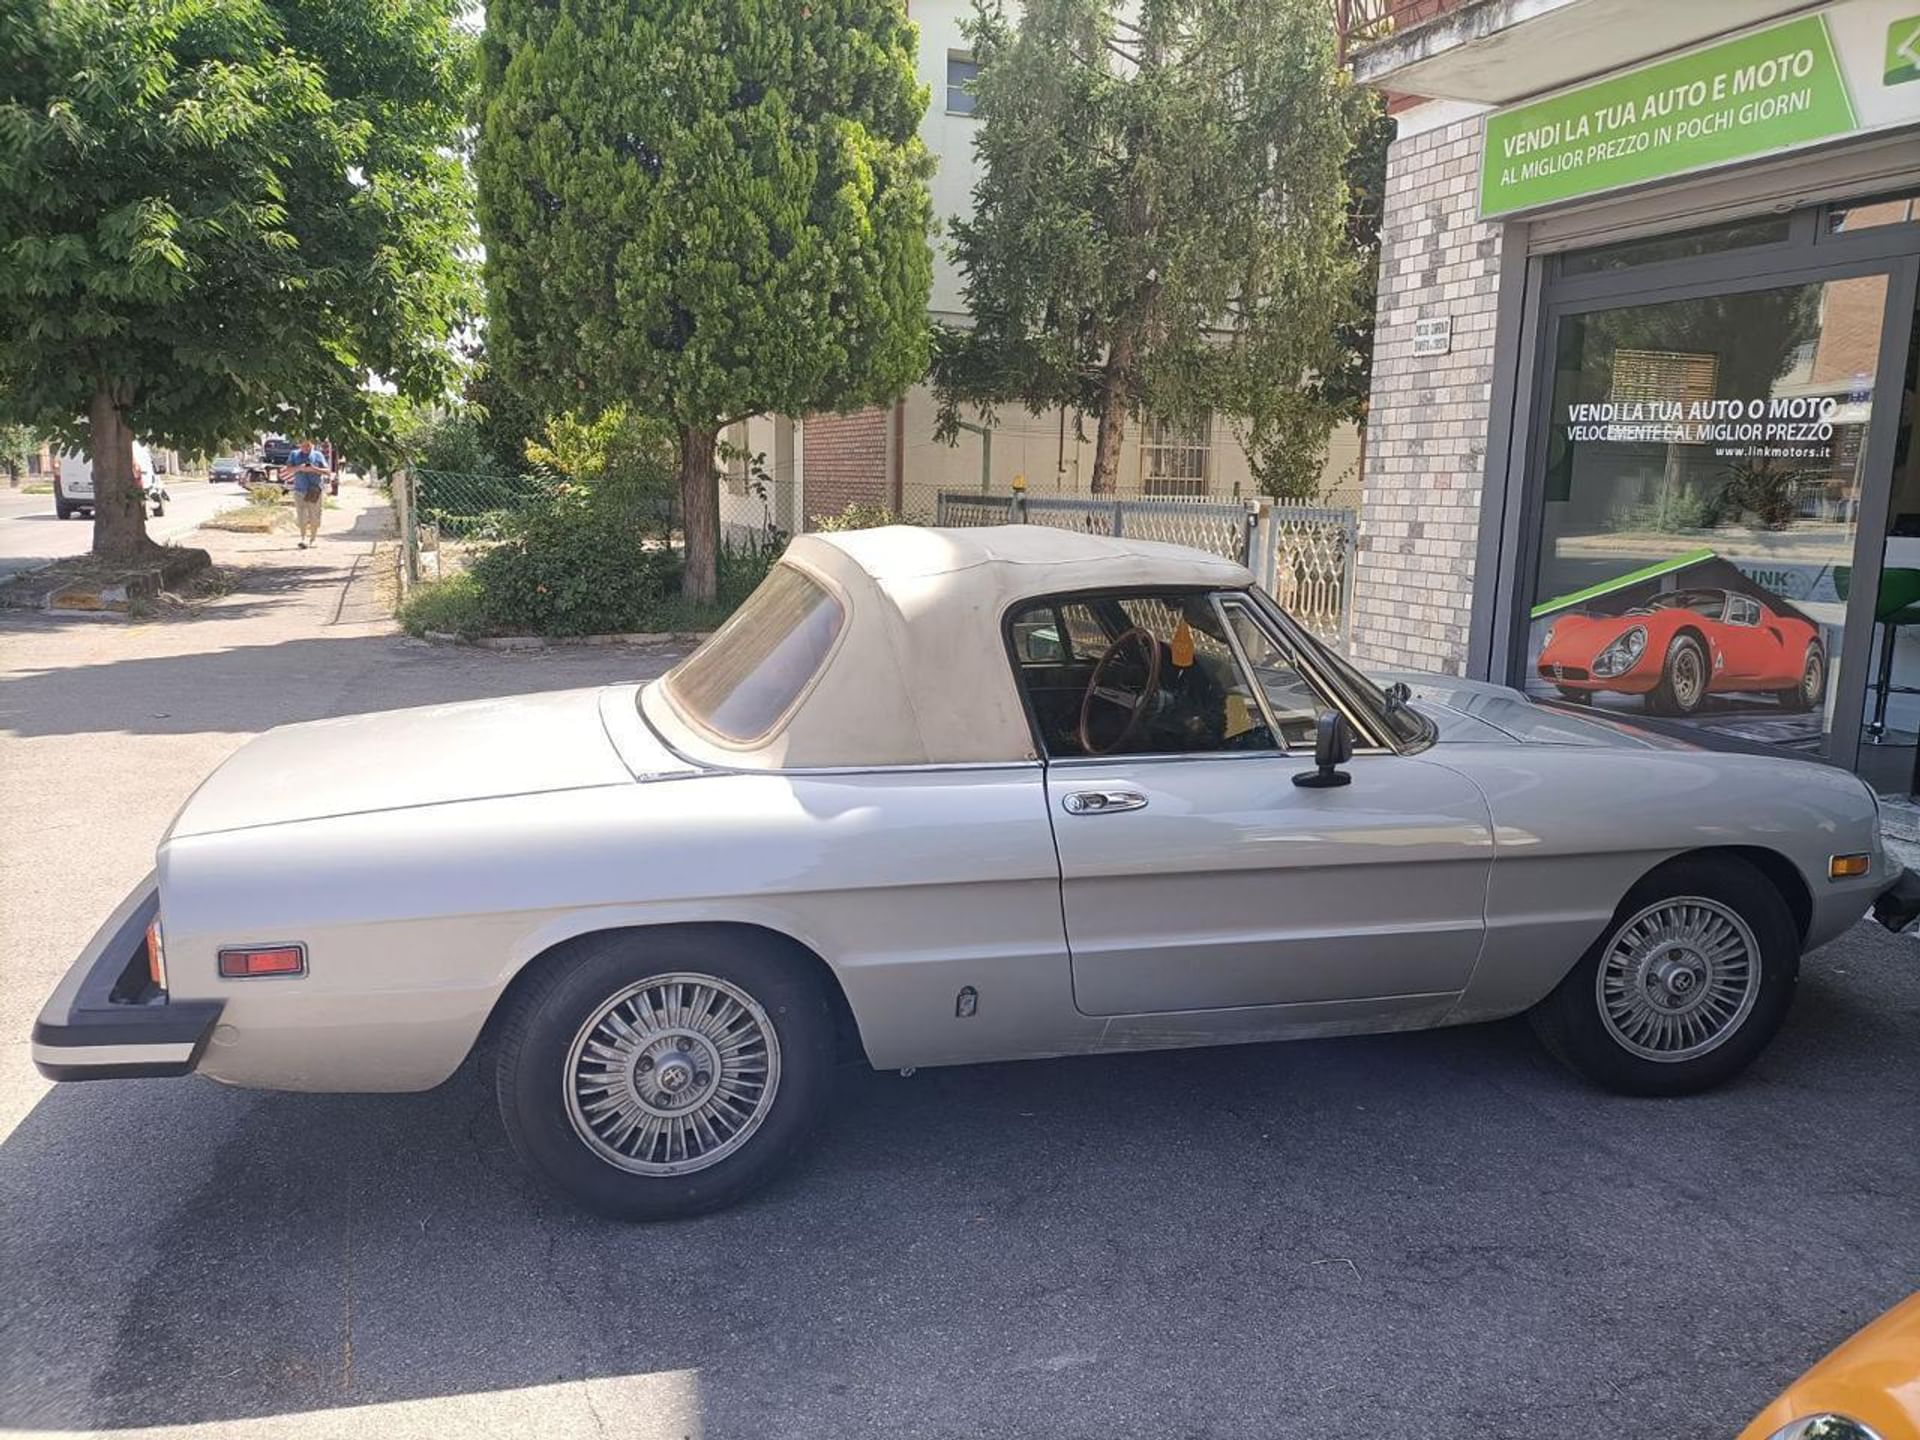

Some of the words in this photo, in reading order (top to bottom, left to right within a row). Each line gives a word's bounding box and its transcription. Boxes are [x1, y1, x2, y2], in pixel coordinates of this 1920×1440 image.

[1503, 122, 1561, 159] VENDI
[1564, 114, 1590, 142] LA
[1594, 101, 1637, 134] TUA
[1640, 80, 1707, 121] AUTO
[1711, 73, 1728, 101] E
[1732, 49, 1815, 96] MOTO
[1500, 166, 1518, 187] AL
[1520, 148, 1584, 182] MIGLIOR
[1586, 131, 1650, 165] PREZZO
[1653, 125, 1672, 147] IN
[1675, 108, 1735, 142] POCHI
[1738, 88, 1812, 125] GIORNI
[1568, 402, 1618, 422] VENDI
[1622, 402, 1644, 421] LA
[1646, 400, 1684, 421] TUA
[1687, 400, 1745, 421] AUTO
[1747, 399, 1766, 420] O
[1768, 397, 1838, 419] MOTO
[1567, 423, 1663, 441] VELOCEMENTE
[1675, 424, 1693, 441] AL
[1696, 423, 1763, 441] MIGLIOR
[1765, 422, 1833, 441] PREZZO
[1715, 445, 1831, 458] www.linkmotors.it
